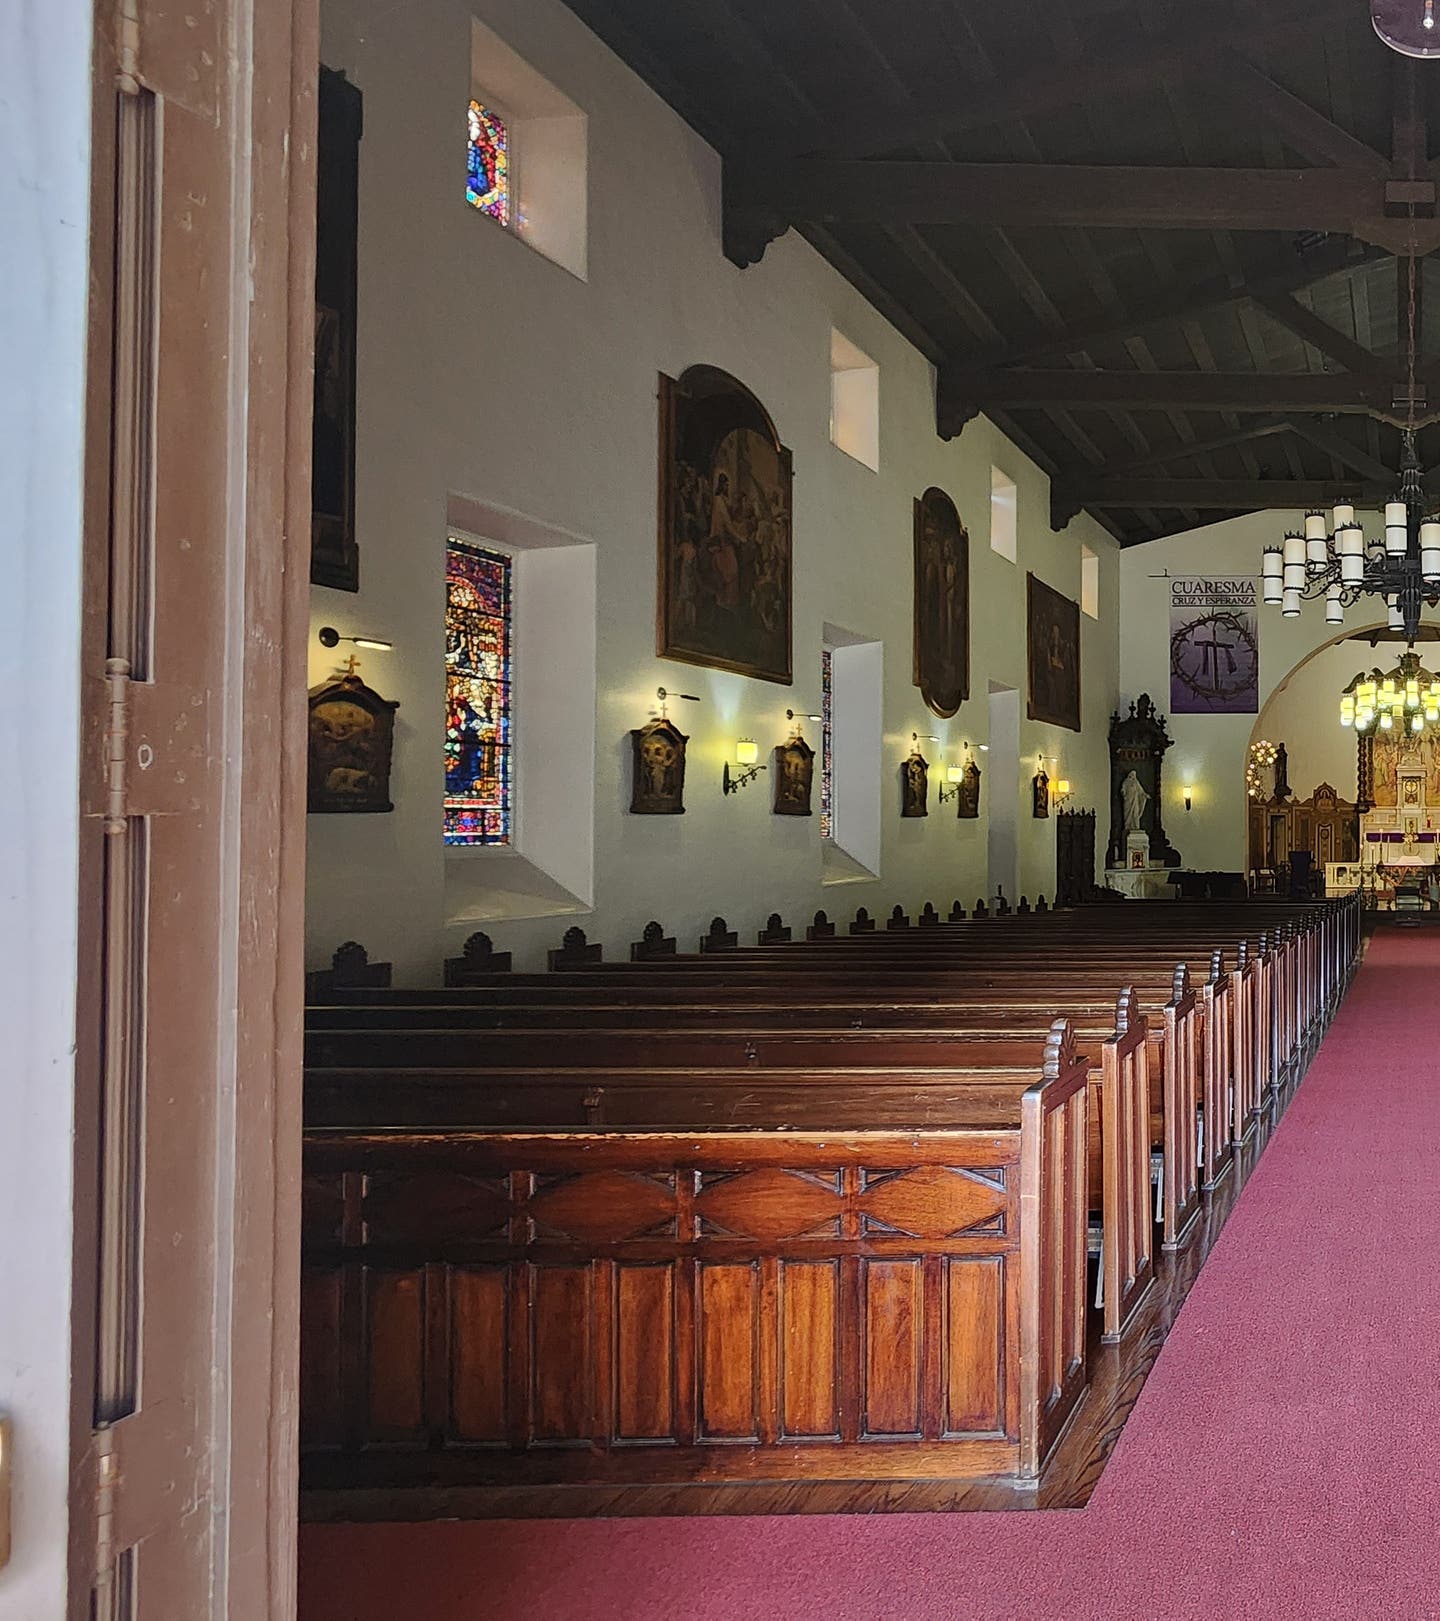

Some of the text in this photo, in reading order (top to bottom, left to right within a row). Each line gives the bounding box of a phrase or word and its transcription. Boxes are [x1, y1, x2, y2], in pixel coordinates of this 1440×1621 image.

[1171, 581, 1256, 594] CUARESMA
[1172, 597, 1256, 605] CRUZ Y ESPERANZA
